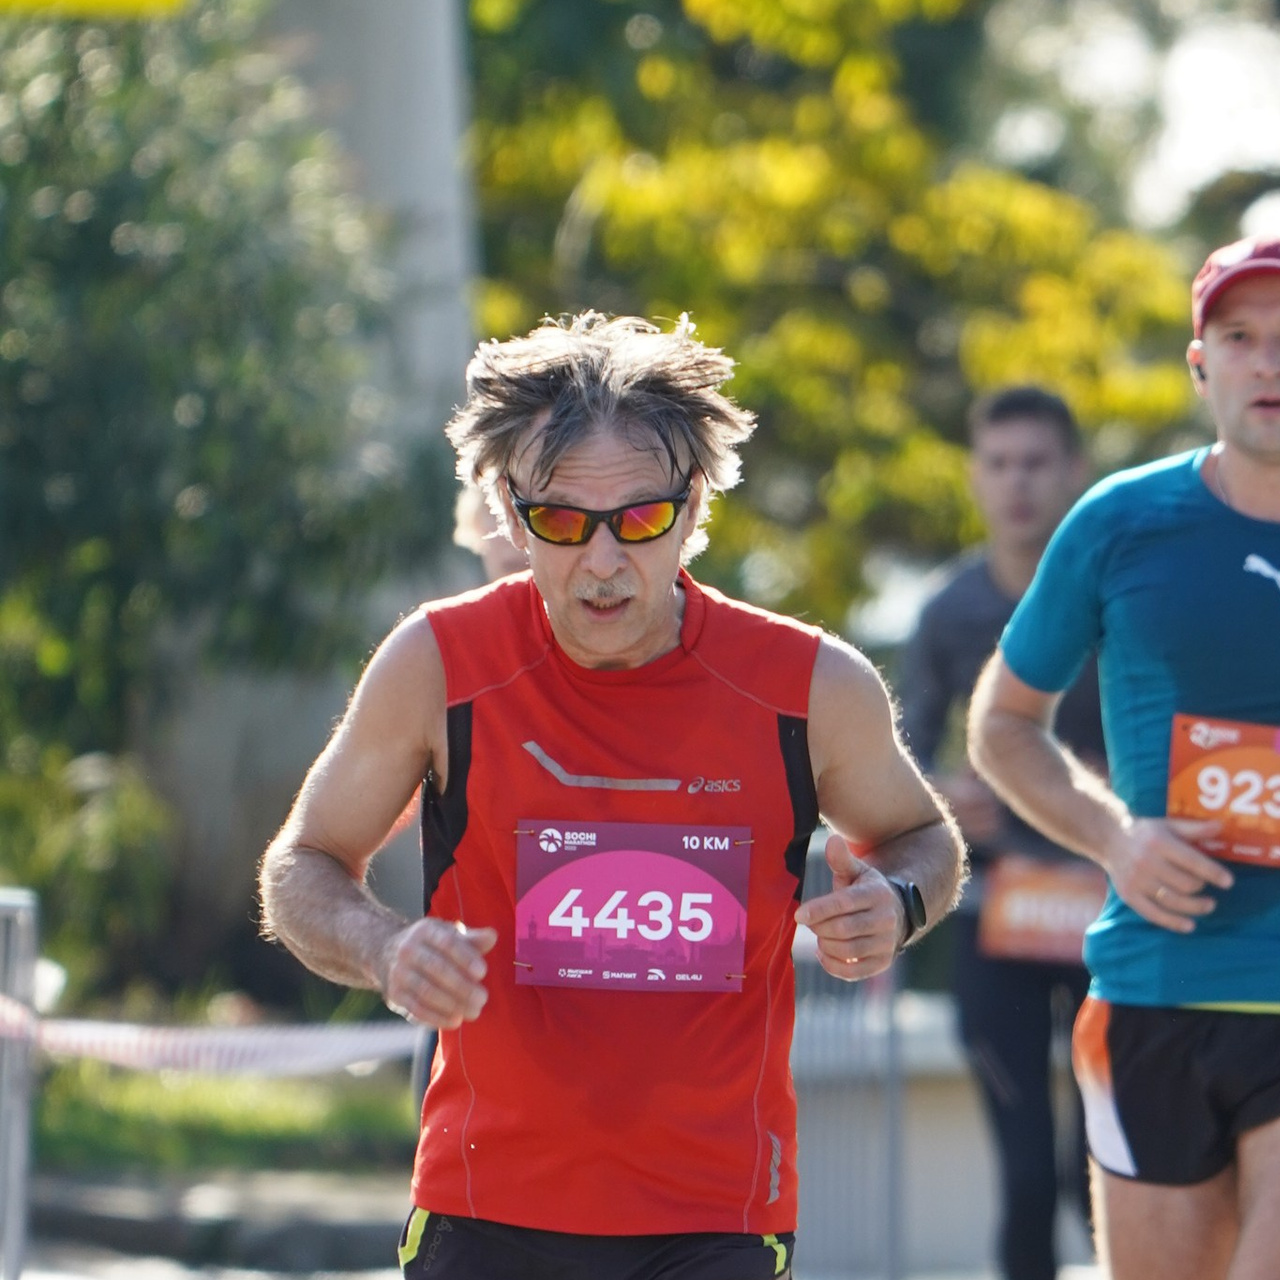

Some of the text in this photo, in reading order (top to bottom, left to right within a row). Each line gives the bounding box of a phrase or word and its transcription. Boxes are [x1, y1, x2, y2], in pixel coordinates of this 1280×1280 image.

[704, 778, 741, 793] asics
[564, 831, 596, 841] SOCHI
[682, 835, 730, 851] 10 KM
[548, 888, 713, 942] 4435
